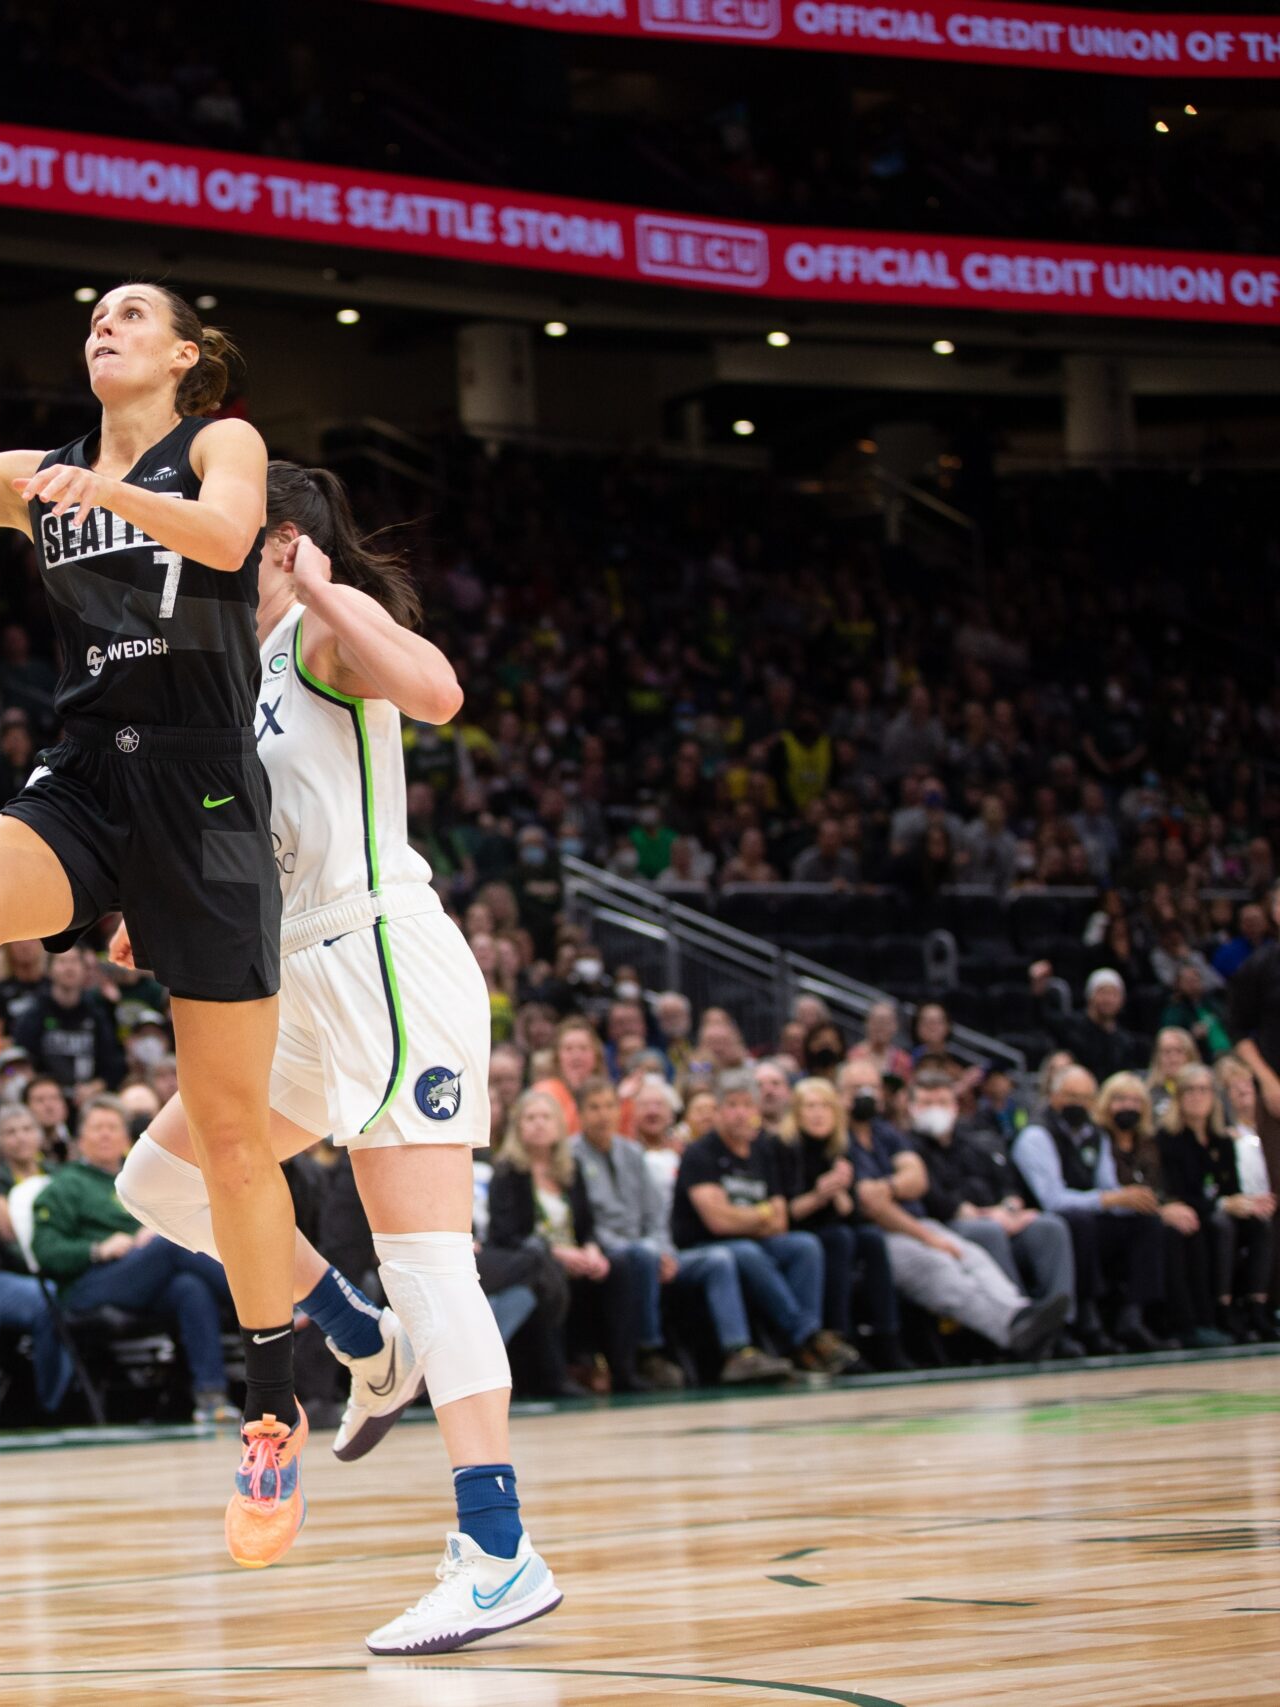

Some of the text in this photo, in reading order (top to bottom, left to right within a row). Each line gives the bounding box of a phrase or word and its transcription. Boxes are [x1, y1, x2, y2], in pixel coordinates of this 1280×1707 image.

[794, 1, 943, 44] OFFICIAL
[946, 14, 1063, 52] CREDIT
[1068, 25, 1180, 62] UNION
[1184, 30, 1235, 62] OF
[64, 151, 200, 207] UNION
[204, 168, 262, 213] OF
[264, 176, 341, 224] THE
[345, 187, 496, 244] SEATTLE
[499, 206, 625, 259] STORM
[651, 231, 758, 275] BECU
[784, 243, 1280, 307] OFFICIAL CREDIT UNION OF
[143, 470, 177, 482] SYMETRA
[43, 505, 156, 564] SEAT
[153, 551, 183, 618] 7
